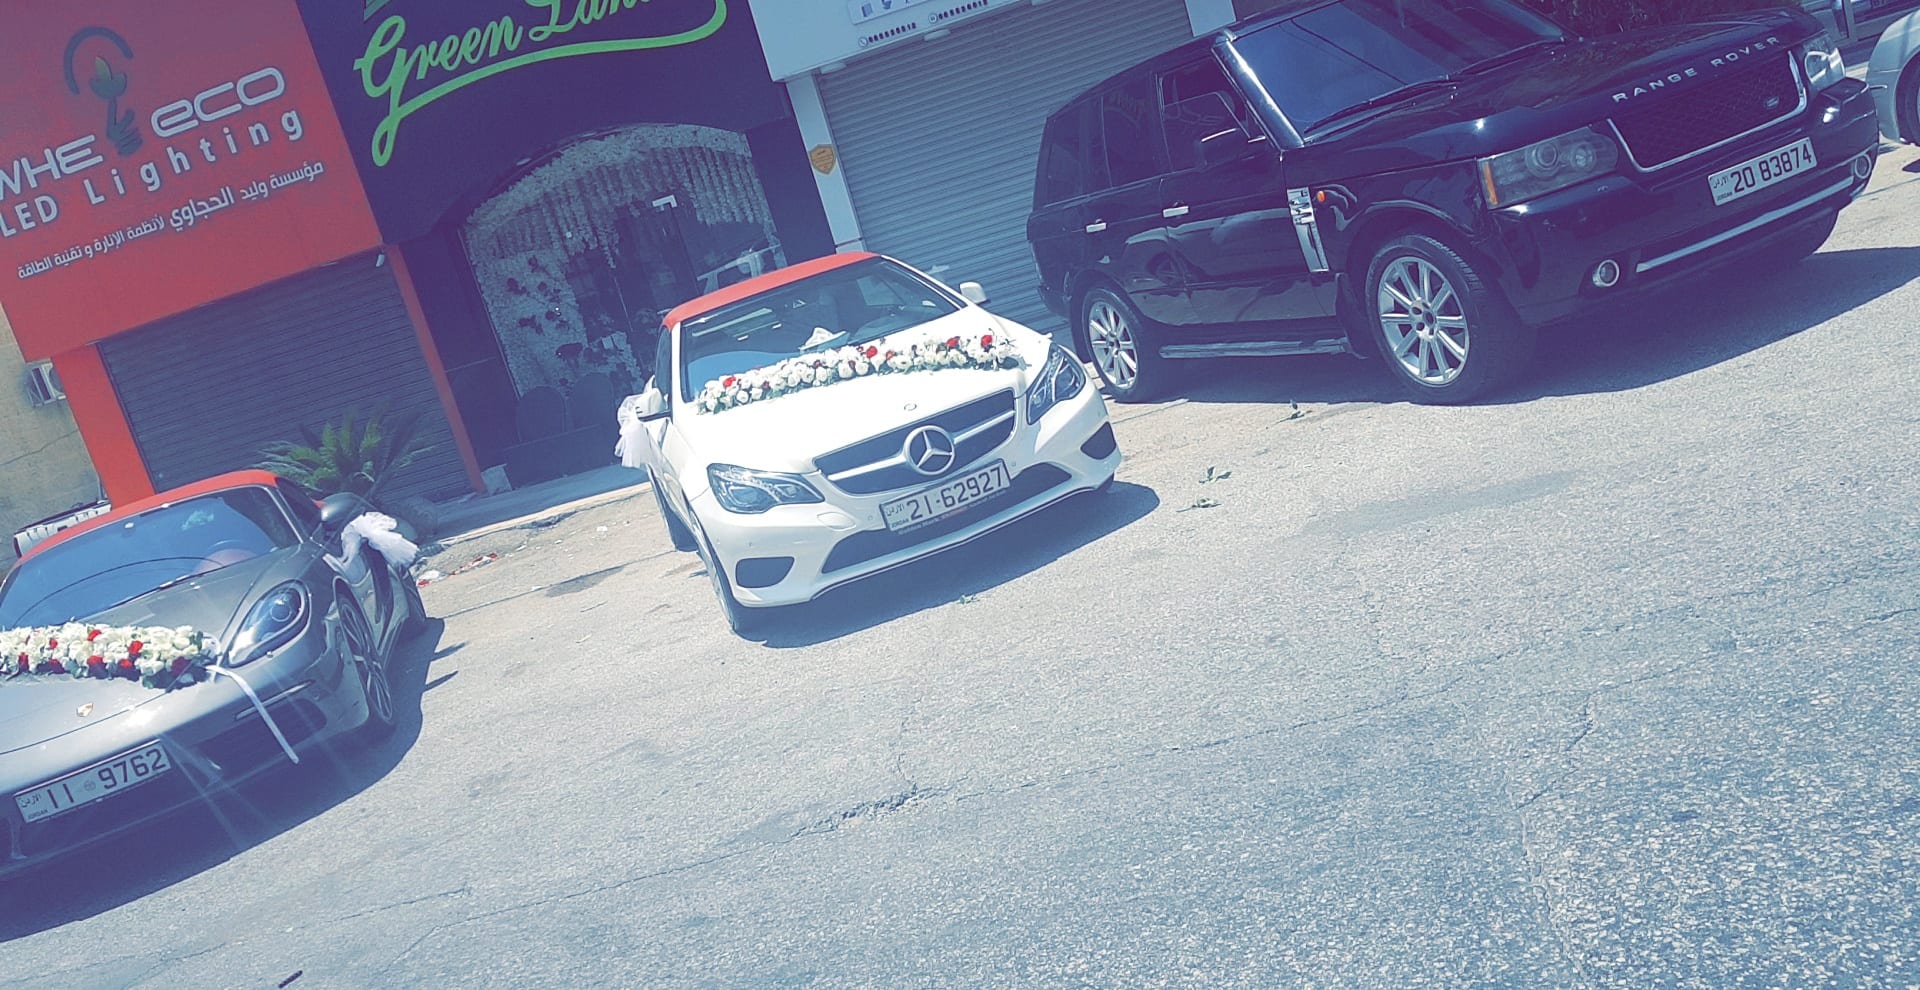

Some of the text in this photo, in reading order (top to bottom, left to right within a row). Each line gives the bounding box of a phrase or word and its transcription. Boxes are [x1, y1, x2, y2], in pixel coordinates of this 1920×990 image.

[353, 15, 523, 167] Green
[1611, 35, 1779, 103] RANGE ROVER
[0, 109, 303, 237] LED Lighting
[269, 160, 324, 190] مؤسسة
[1730, 143, 1812, 193] 20 83874
[169, 186, 235, 232] الحجاوي
[240, 180, 269, 201] وليد
[18, 255, 53, 279] الطاقة
[54, 246, 83, 268] تقنية
[98, 748, 167, 790] 9762
